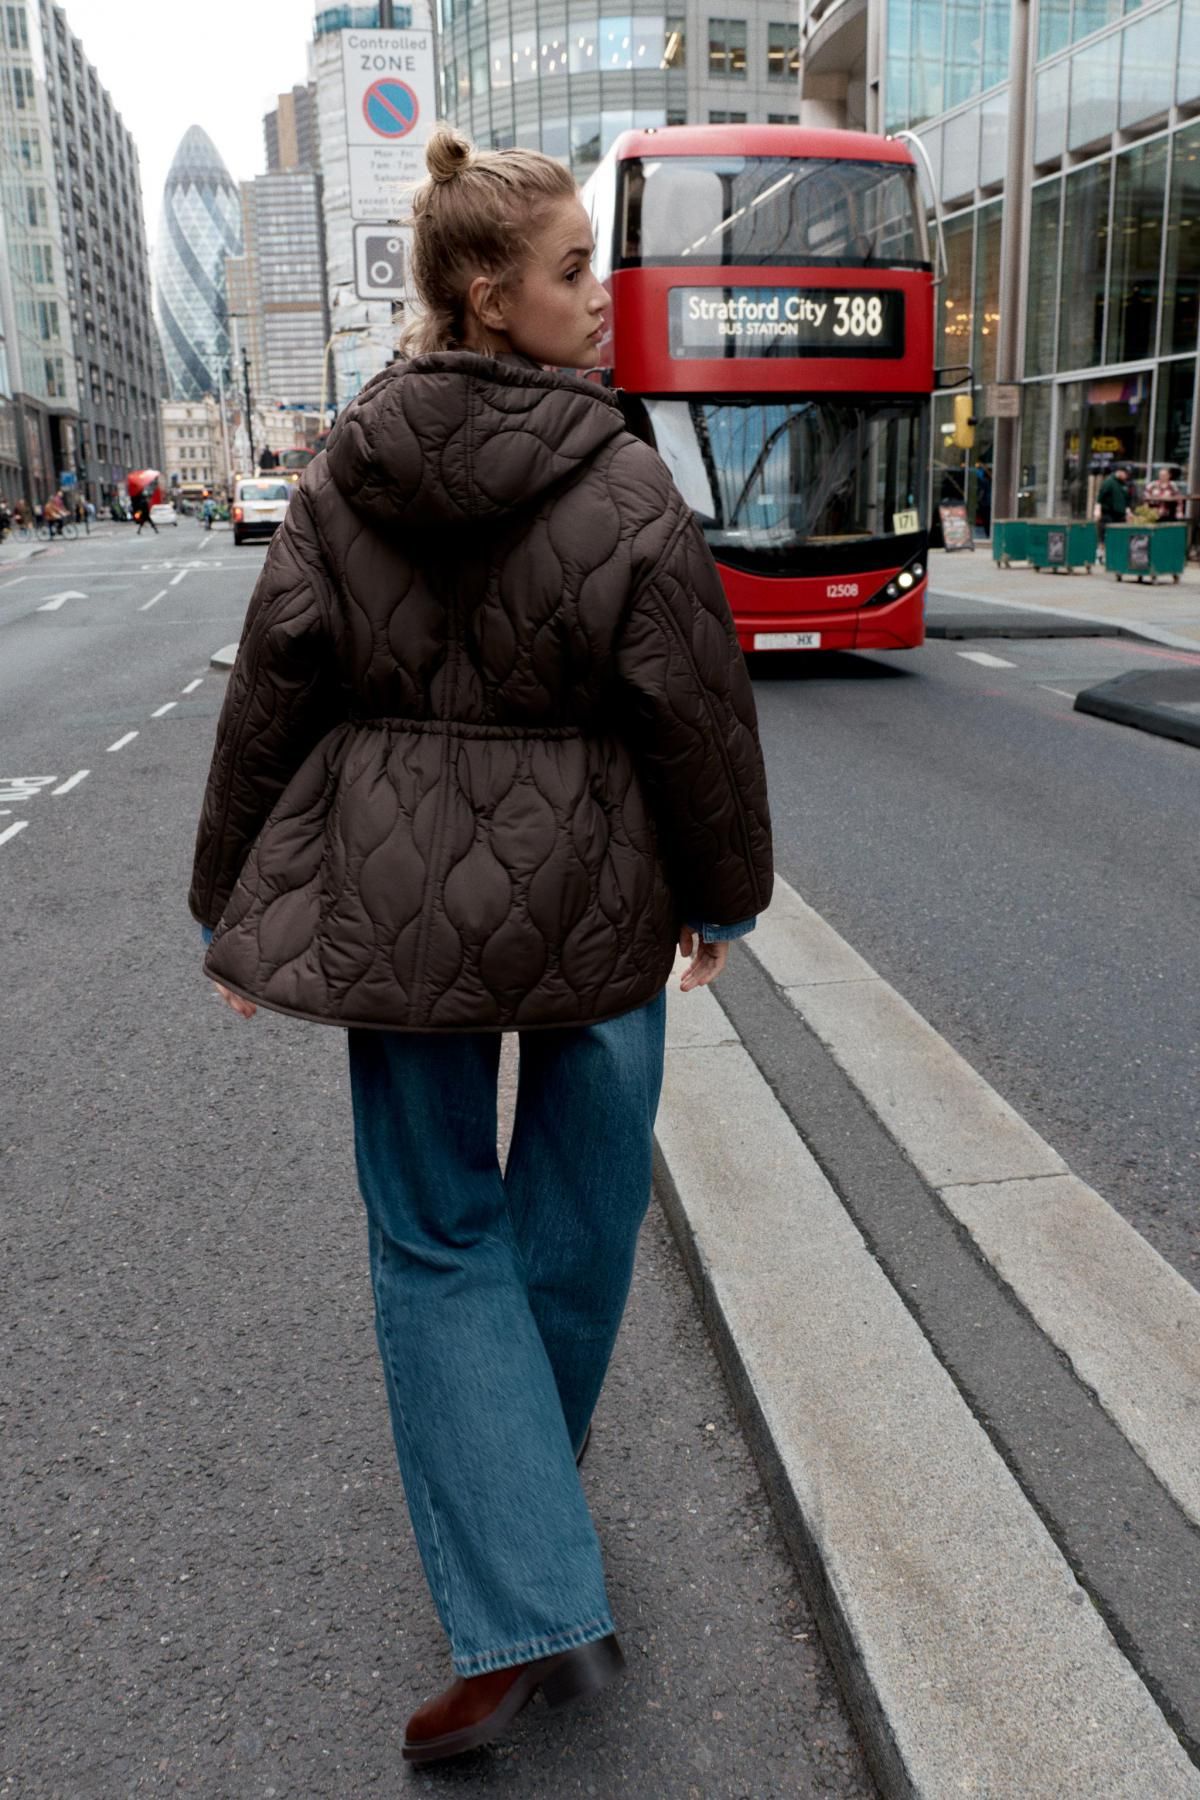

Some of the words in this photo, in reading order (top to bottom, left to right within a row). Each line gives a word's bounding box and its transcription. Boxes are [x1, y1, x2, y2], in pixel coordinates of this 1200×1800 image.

[348, 36, 427, 50] Controlled
[361, 55, 416, 71] ZONE
[688, 295, 780, 320] Stratford
[784, 295, 828, 327] City
[832, 296, 883, 336] 388
[718, 322, 743, 335] BUS
[746, 322, 799, 335] STATION
[899, 515, 915, 529] 171
[826, 583, 859, 598] 12508
